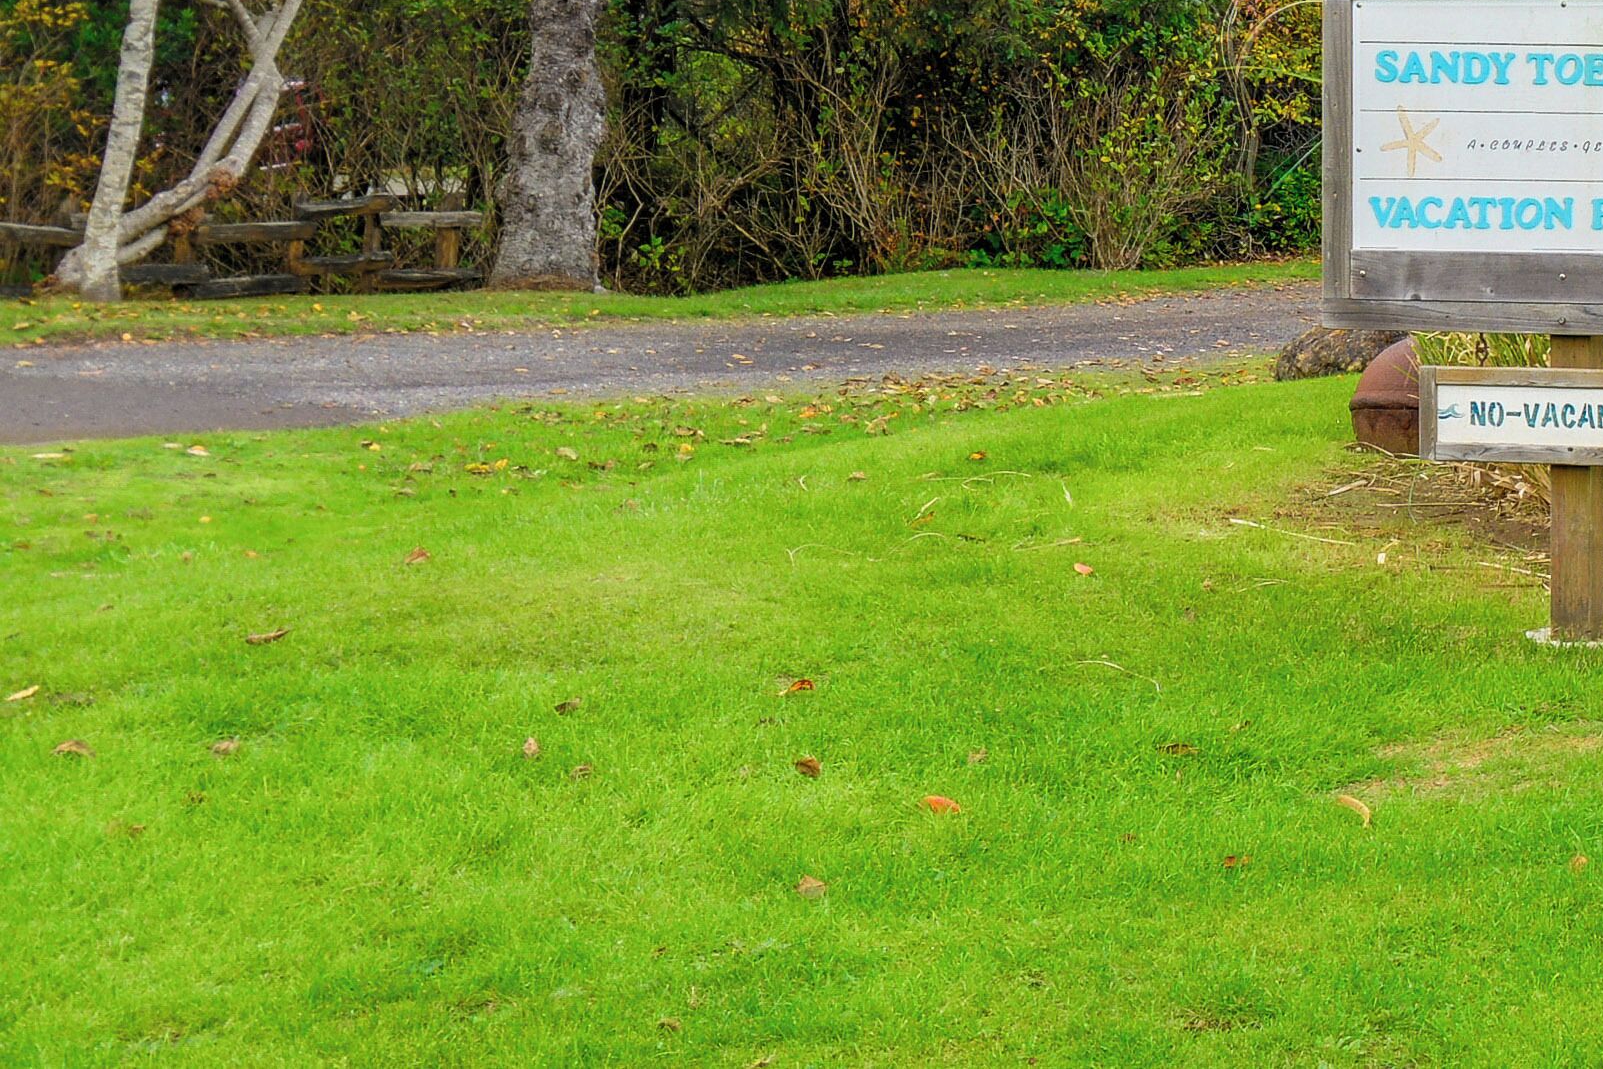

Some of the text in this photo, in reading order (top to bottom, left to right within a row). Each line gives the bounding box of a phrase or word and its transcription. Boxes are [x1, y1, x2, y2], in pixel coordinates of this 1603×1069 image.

[1375, 50, 1517, 85] SANDY
[1489, 139, 1569, 152] COUPLES
[1368, 196, 1574, 230] VACATION
